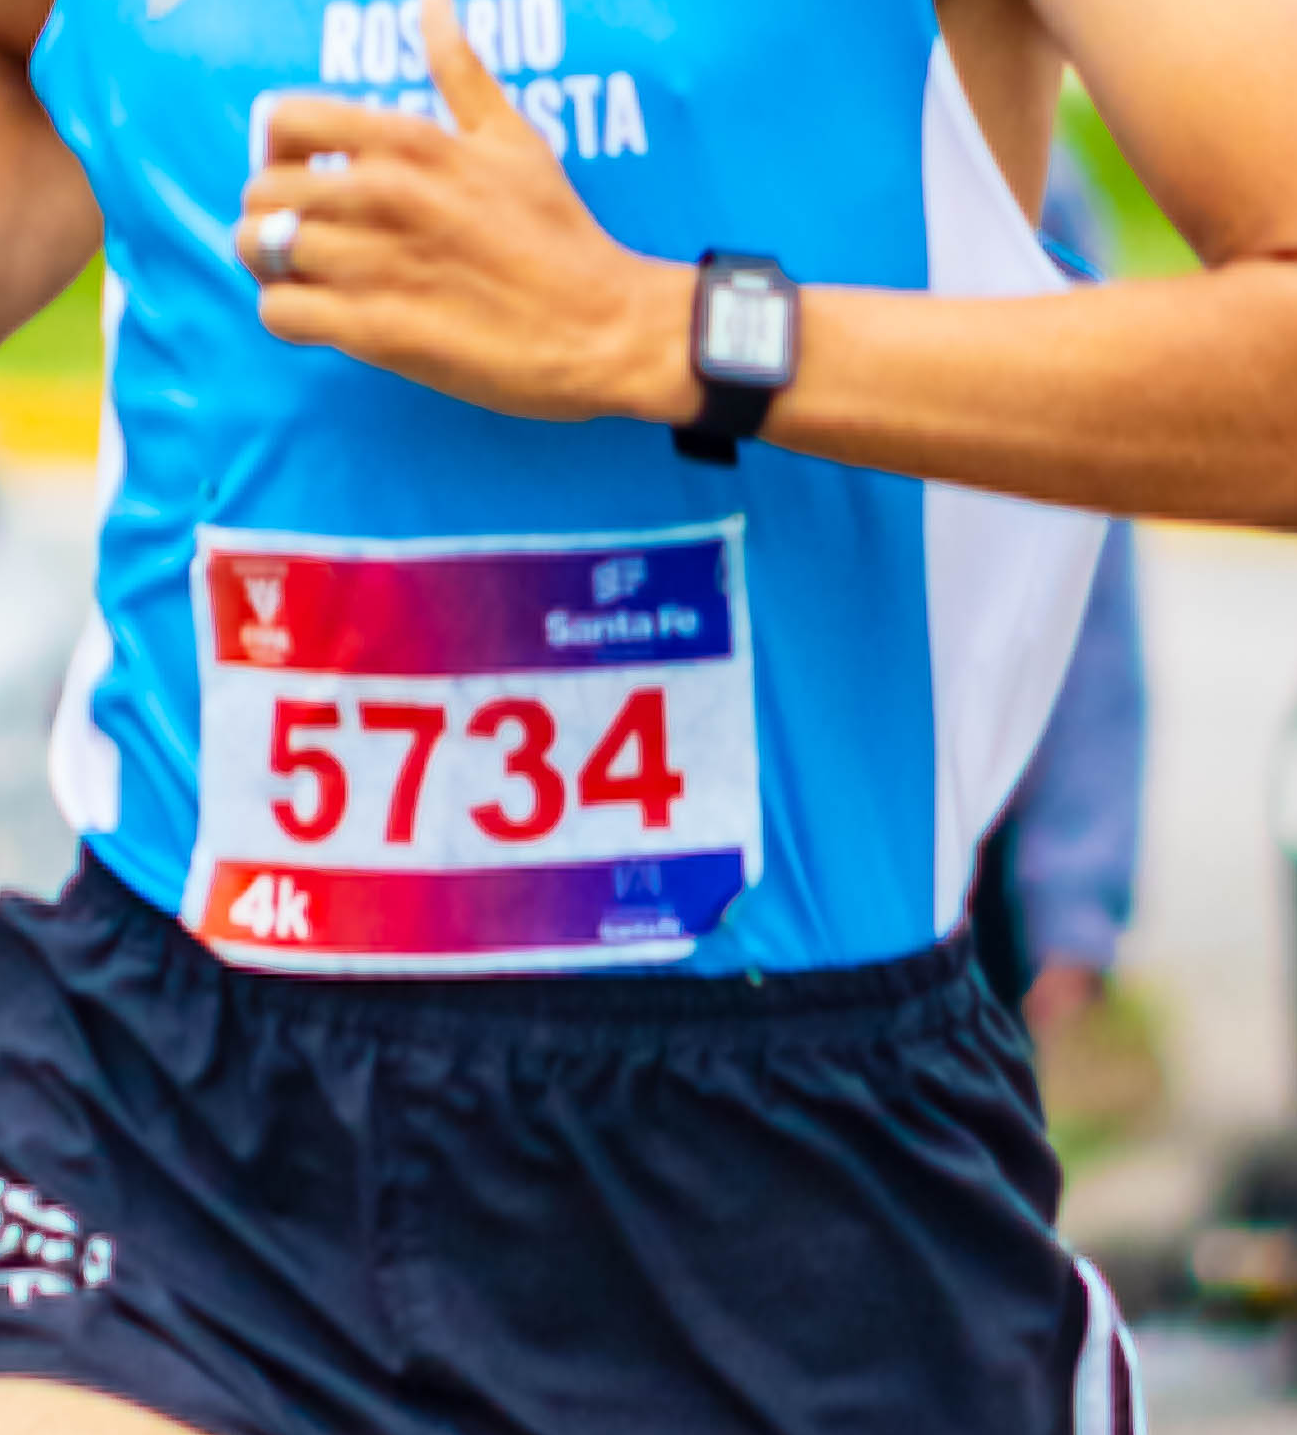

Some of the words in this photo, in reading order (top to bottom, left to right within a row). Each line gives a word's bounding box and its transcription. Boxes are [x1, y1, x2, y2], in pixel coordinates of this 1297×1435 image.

[546, 607, 653, 648] Santa
[657, 602, 700, 640] Fe
[271, 686, 684, 845] 5734
[230, 874, 310, 939] 4k
